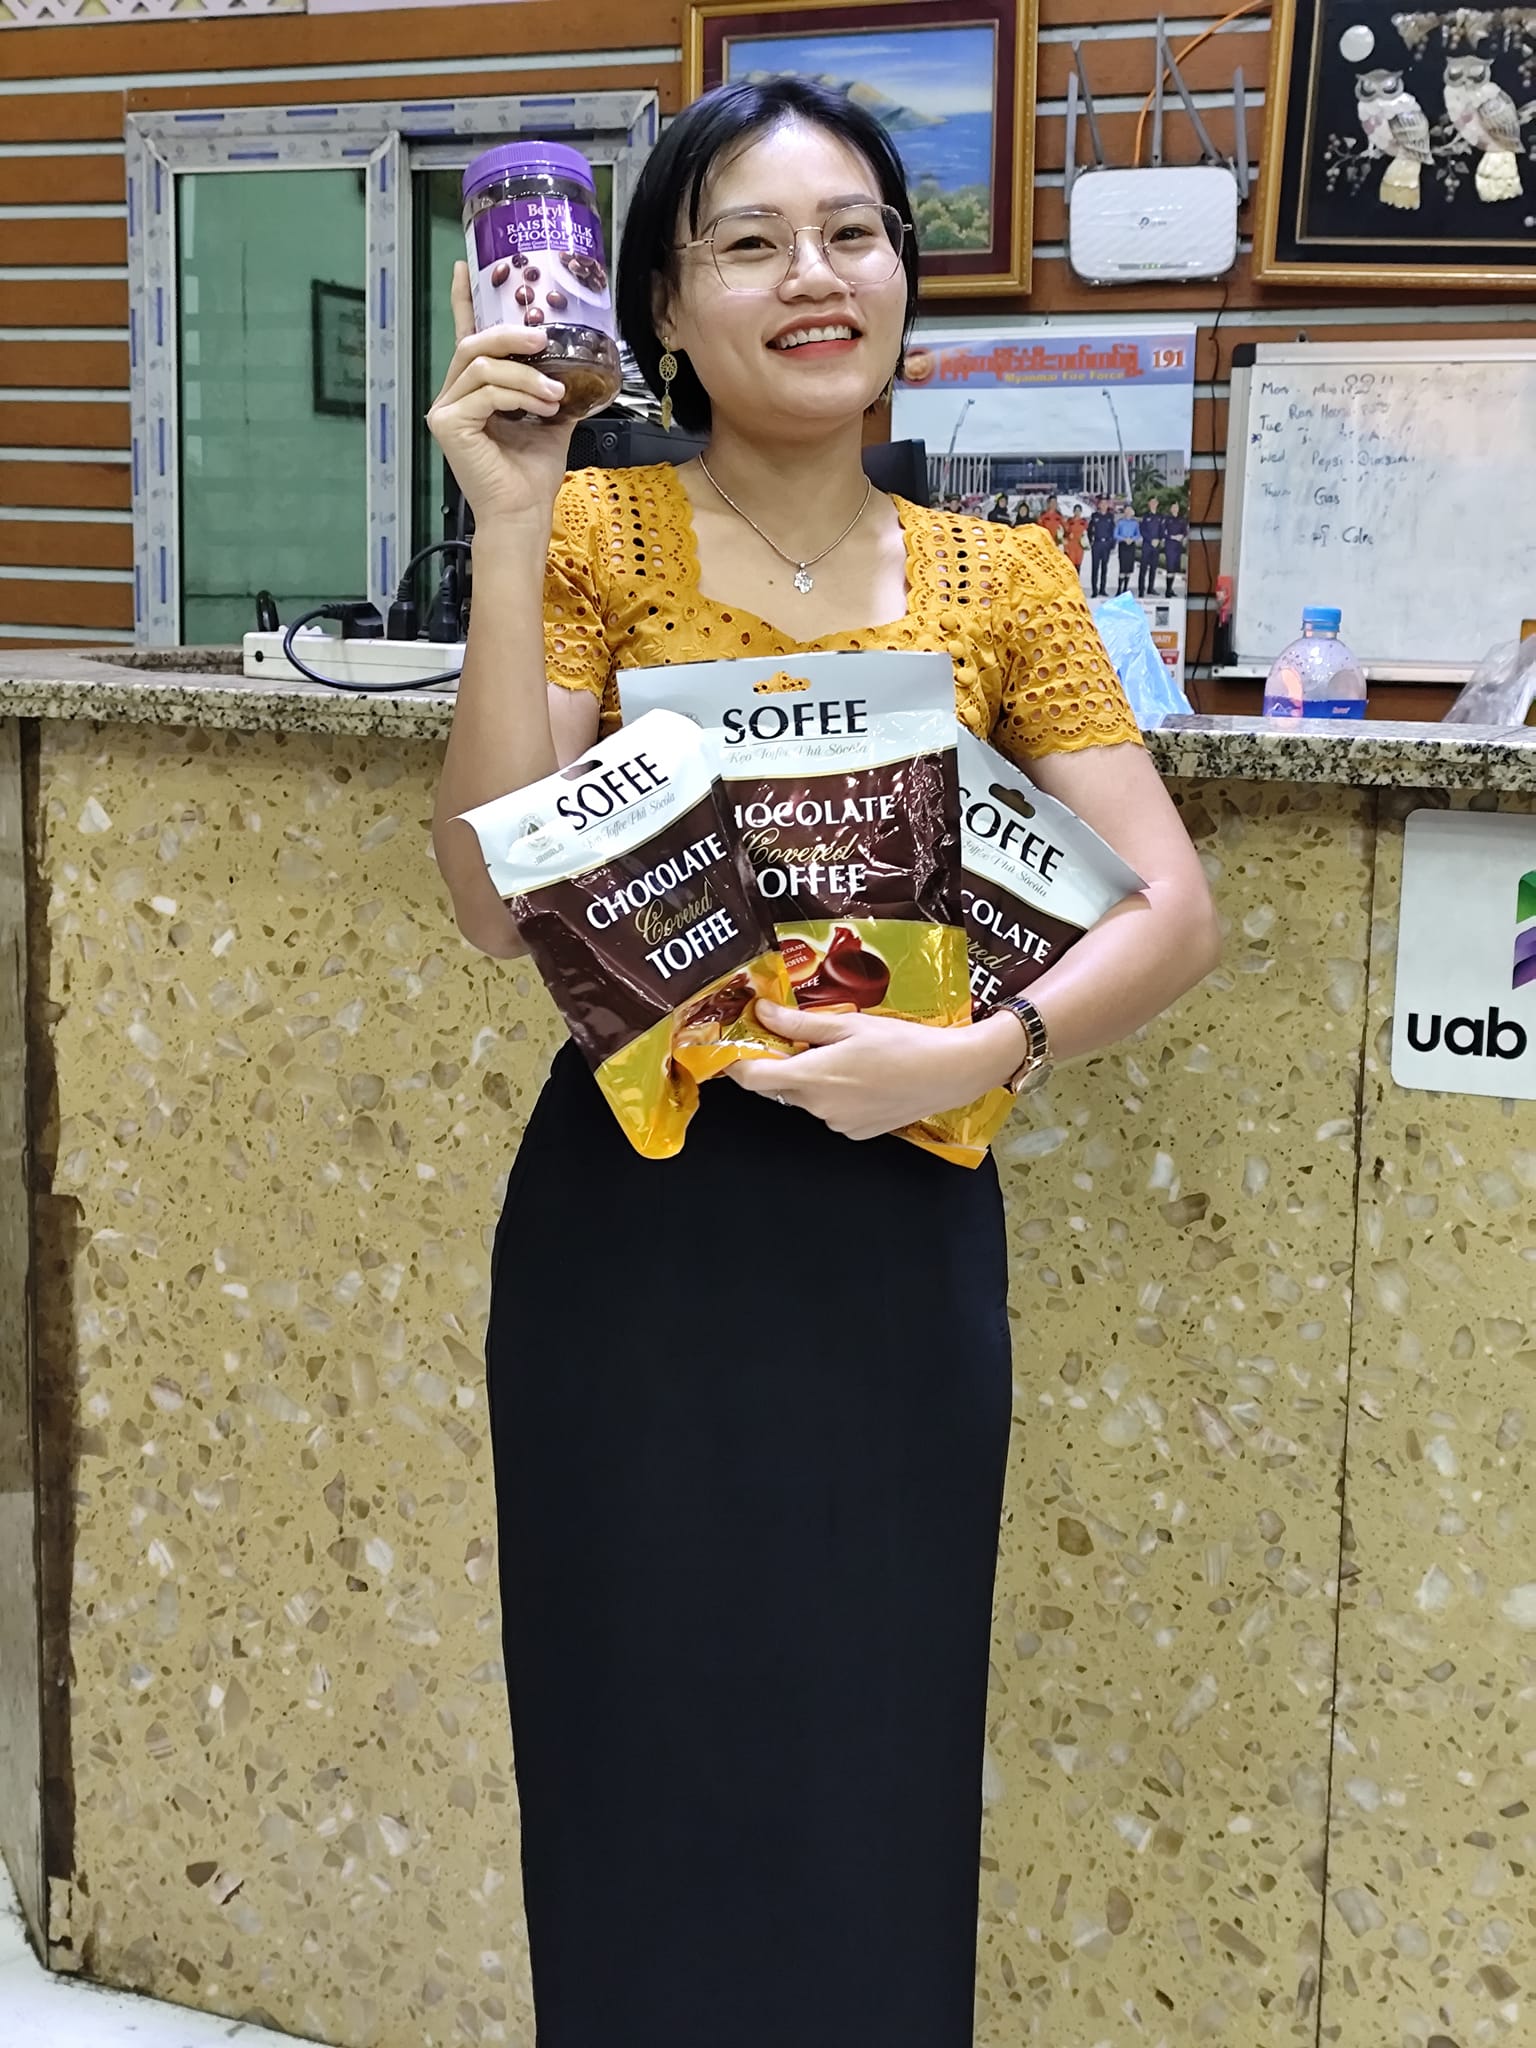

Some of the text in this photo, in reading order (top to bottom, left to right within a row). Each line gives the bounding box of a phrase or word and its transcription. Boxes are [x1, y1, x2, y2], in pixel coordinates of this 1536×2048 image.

[506, 219, 557, 235] RAISIN
[527, 203, 570, 219] Beryl'
[508, 230, 593, 248] CHOCOLATE
[1005, 369, 1125, 384] Myanmar Fire Force
[1152, 349, 1185, 369] 191
[1260, 415, 1283, 433] Tue
[722, 700, 868, 744] SOFEE
[556, 752, 669, 831] SOFEE
[734, 794, 896, 829] OCOLATE
[742, 827, 860, 866] Covered
[586, 833, 728, 929] CHOCOLATE
[756, 862, 869, 899] OFFEE
[635, 876, 714, 945] Covered
[960, 889, 1052, 965] COLATE
[645, 908, 740, 980] TOFFEE
[1407, 1006, 1528, 1060] uab
